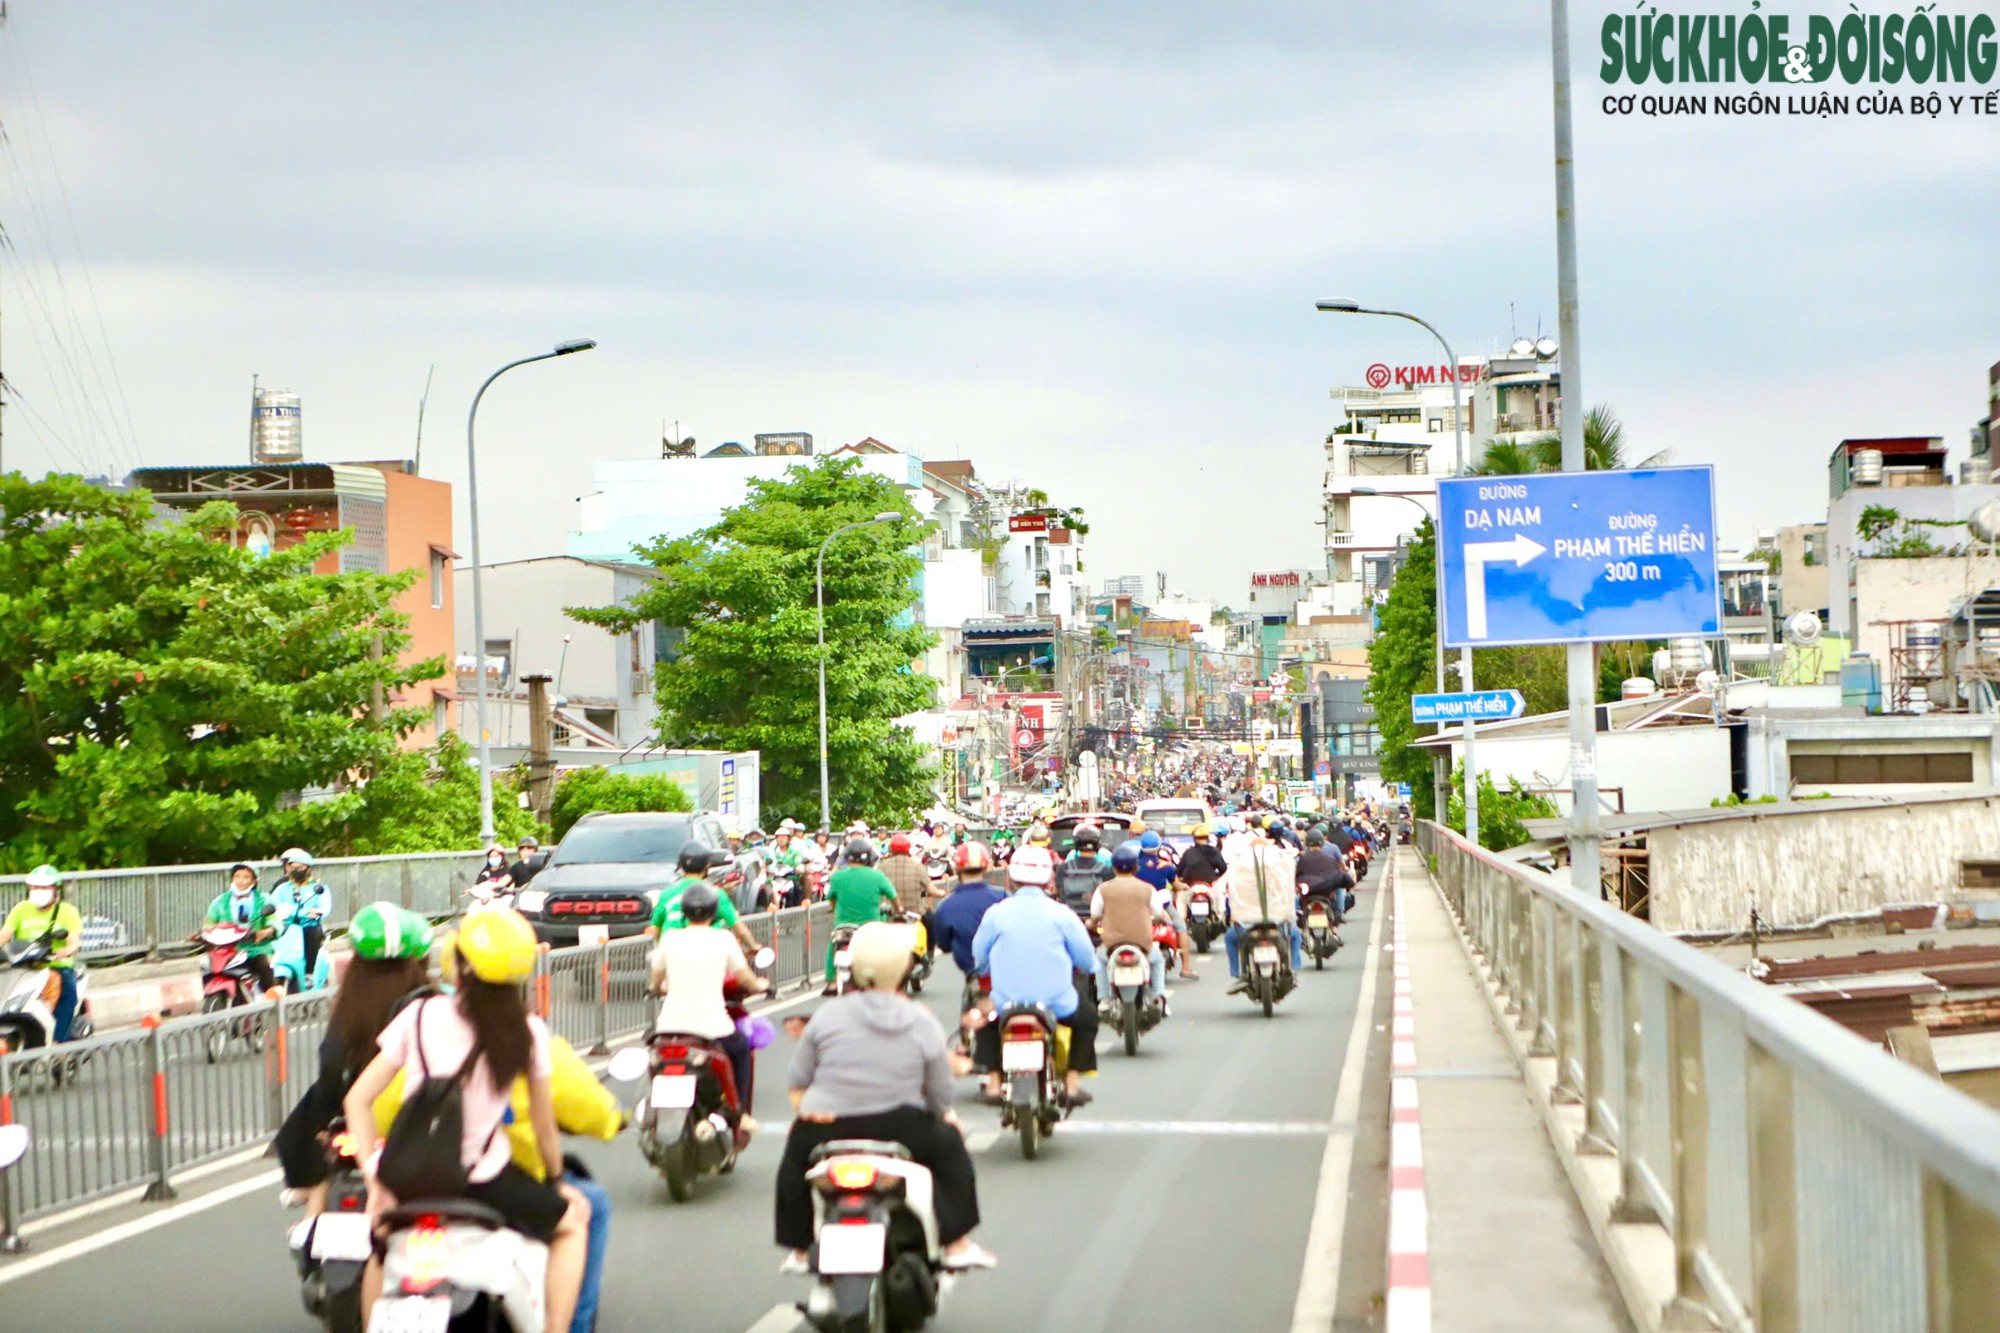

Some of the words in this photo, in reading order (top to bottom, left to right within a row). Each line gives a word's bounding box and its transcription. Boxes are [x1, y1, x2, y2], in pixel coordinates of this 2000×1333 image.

[1395, 366, 1435, 384] KIM
[1478, 482, 1528, 500] ĐƯỜNG
[1464, 508, 1493, 532] DẠ
[1496, 505, 1542, 527] NAM
[1608, 510, 1658, 530] ĐƯỜNG
[1554, 536, 1612, 561] PHẠM
[1615, 527, 1656, 555] THẾ
[1658, 523, 1705, 553] HIỂN
[1604, 561, 1639, 582] 300
[1642, 564, 1661, 580] m
[1435, 701, 1464, 718] PHẠM
[1464, 696, 1484, 713] THẾ
[1484, 694, 1508, 712] HIỂN
[552, 900, 640, 914] FORD
